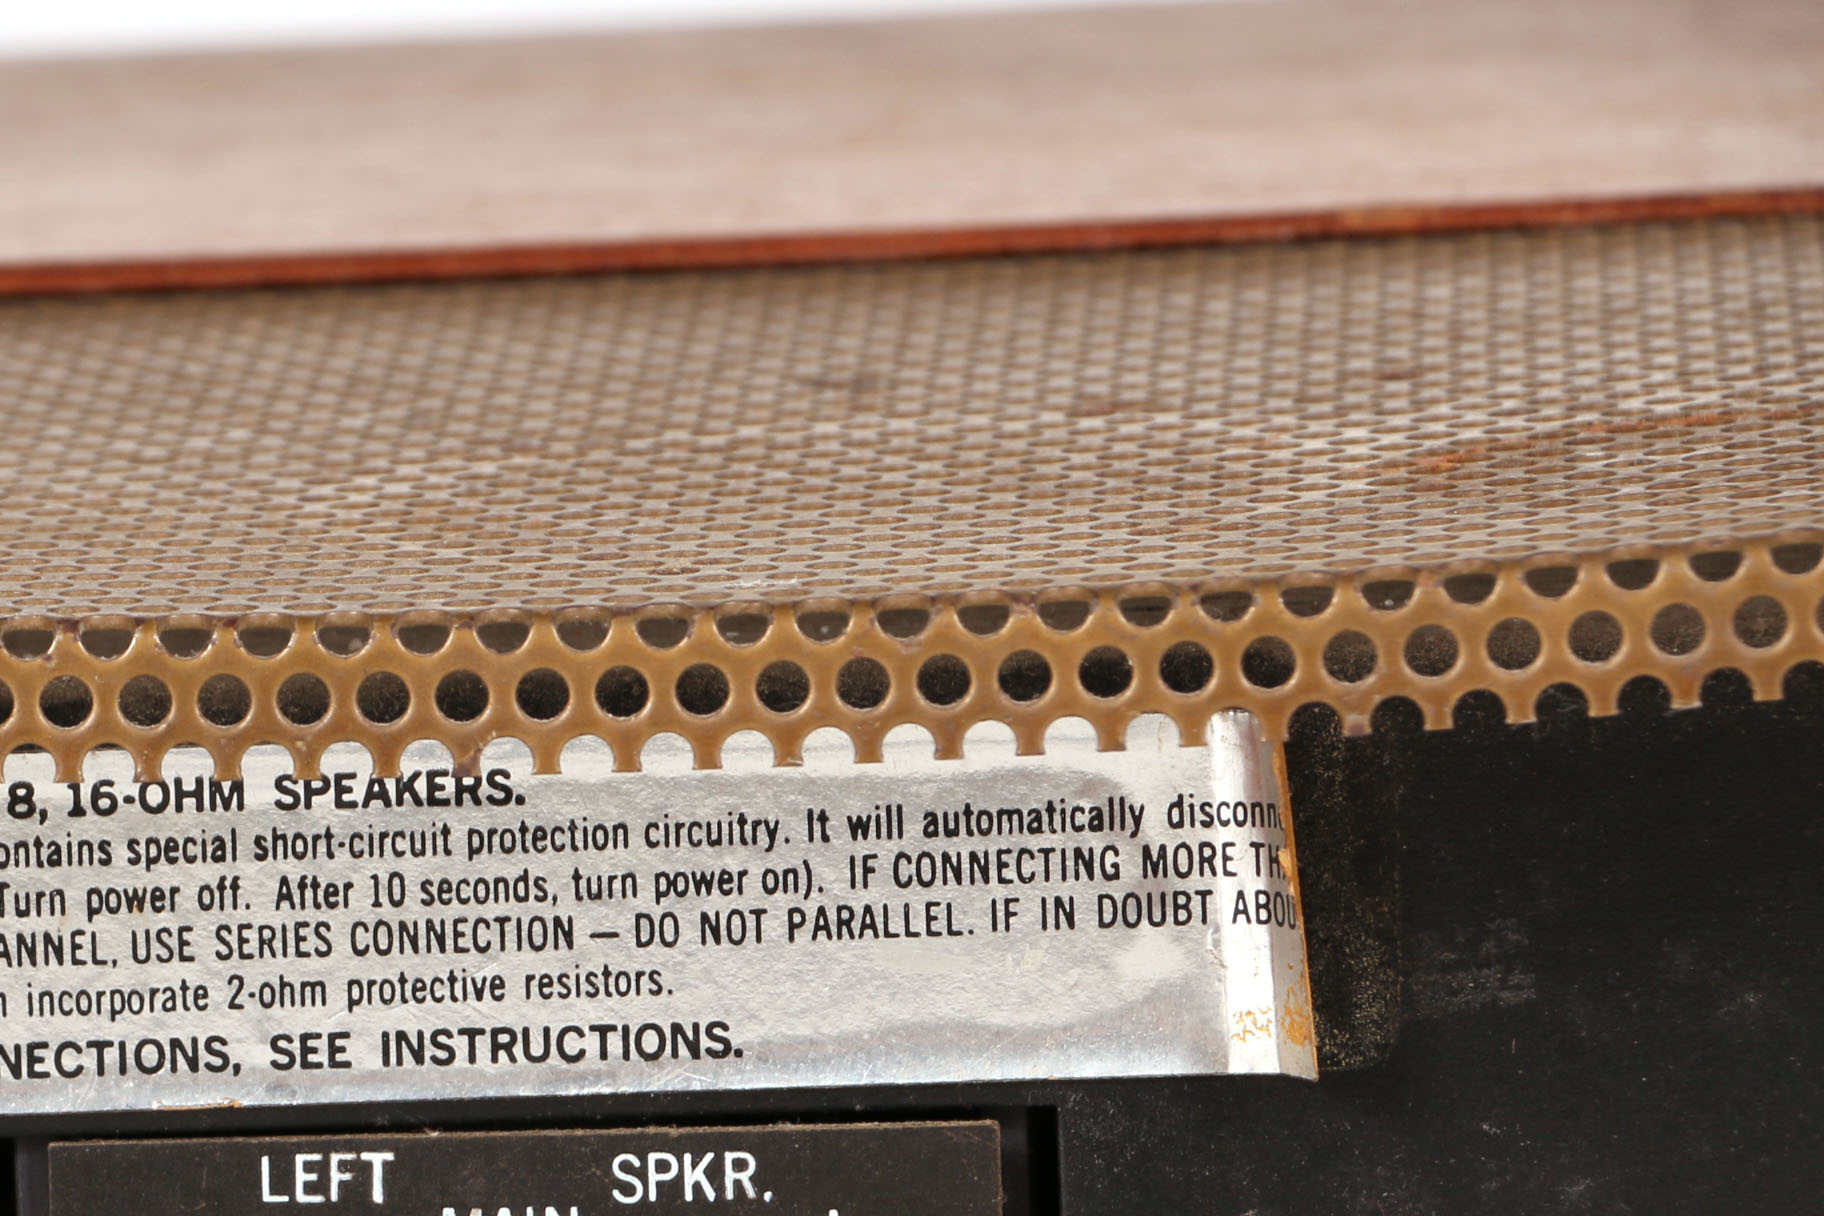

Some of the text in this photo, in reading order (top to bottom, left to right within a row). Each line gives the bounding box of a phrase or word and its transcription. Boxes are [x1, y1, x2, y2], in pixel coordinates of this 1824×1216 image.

[7, 781, 48, 826] 8,
[67, 776, 245, 818] 16-OHM
[274, 764, 526, 812] SPEAKERS.
[126, 827, 238, 872] special
[253, 822, 452, 862] short-circuit
[467, 816, 629, 862] protection
[644, 811, 791, 853] circuitry.
[806, 808, 831, 844] It
[846, 803, 904, 842] will
[922, 796, 1145, 839] automatically
[86, 886, 181, 923] power
[197, 875, 251, 912] off.
[275, 874, 354, 911] After
[370, 871, 406, 908] 10
[420, 868, 558, 907] seconds,
[571, 867, 638, 902] turn
[654, 868, 749, 906] power
[761, 859, 824, 901] on).
[849, 853, 879, 890] IF
[892, 844, 1121, 889] CONNECTING
[1142, 841, 1237, 880] MORE
[1249, 841, 1287, 881] TH
[131, 925, 195, 965] USE
[215, 920, 333, 961] SERIES
[350, 915, 574, 957] CONNECTION
[634, 911, 680, 948] DO
[700, 908, 768, 946] NOT
[787, 901, 974, 943] PARALLEL.
[991, 897, 1020, 933] IF
[1041, 895, 1076, 931] IN
[1097, 889, 1214, 929] DOUBT
[27, 979, 209, 1022] incorporate
[227, 974, 327, 1010] 2-ohm
[347, 969, 506, 1013] protective
[525, 964, 673, 1000] resistors.
[269, 1031, 352, 1071] SEE
[381, 1021, 744, 1068] INSTRUCTIONS.
[260, 1150, 773, 1205] LEFT SPKR.
